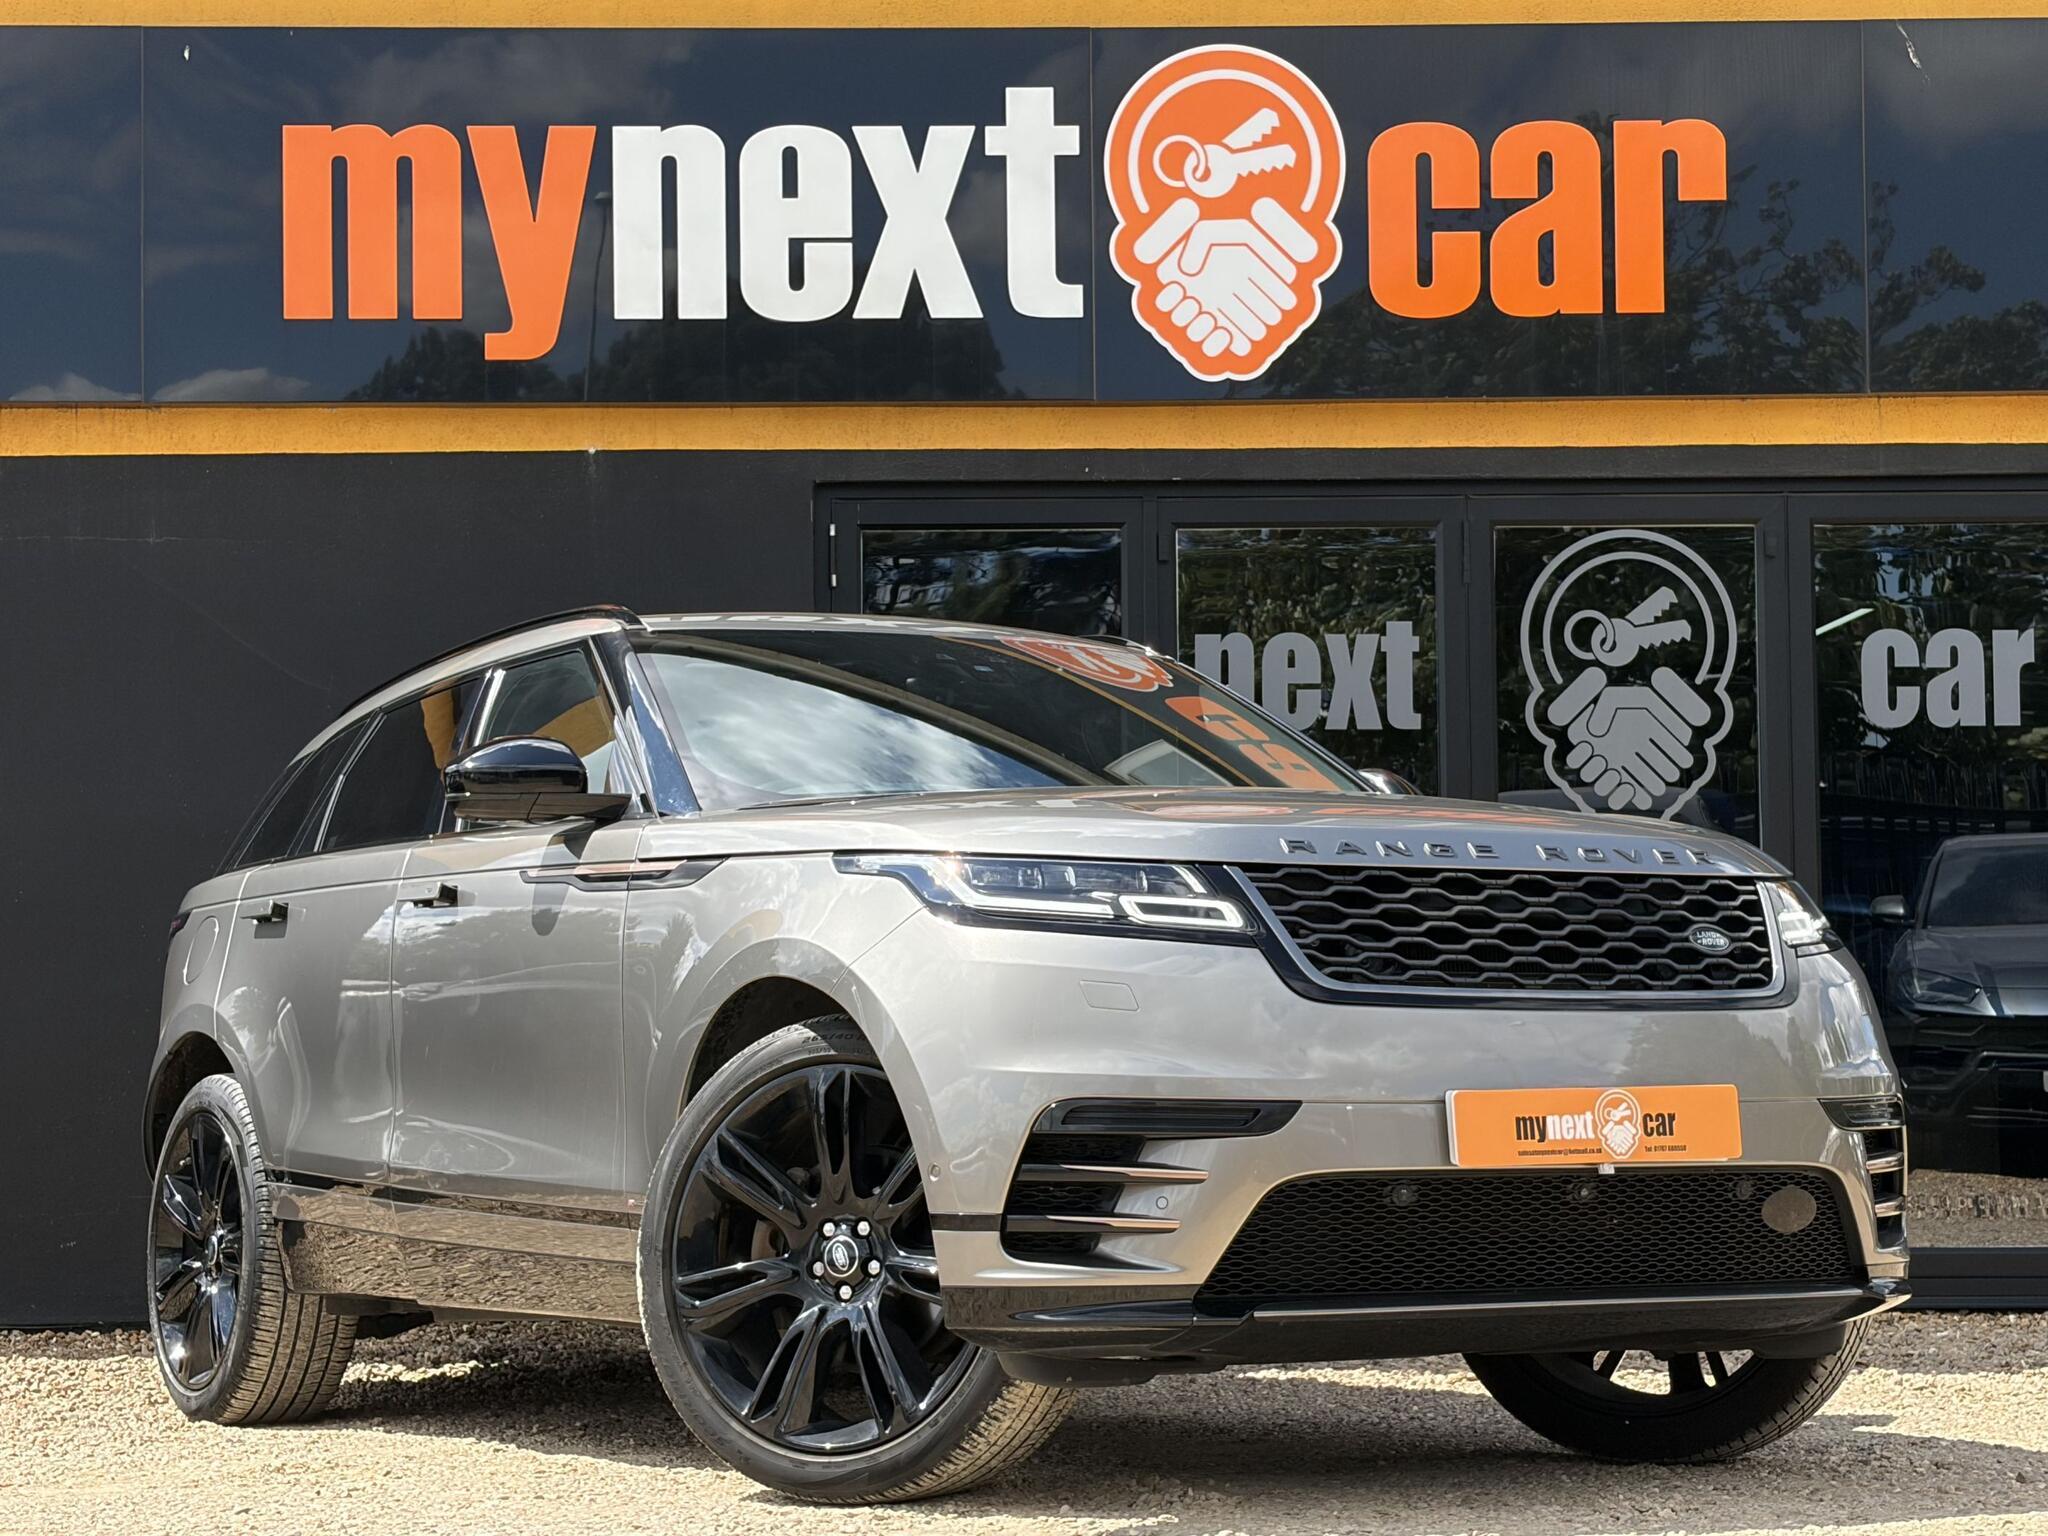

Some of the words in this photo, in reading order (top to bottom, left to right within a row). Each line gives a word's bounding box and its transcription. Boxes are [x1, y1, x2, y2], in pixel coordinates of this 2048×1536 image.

[1368, 119, 1727, 318] car
[1195, 621, 1422, 731] next
[1861, 628, 2035, 728] car
[1279, 837, 1499, 859] RANGE
[1536, 844, 1716, 865] ROVER
[1696, 930, 1717, 939] LAND
[1702, 937, 1725, 946] ROVER
[1642, 1112, 1676, 1137] car
